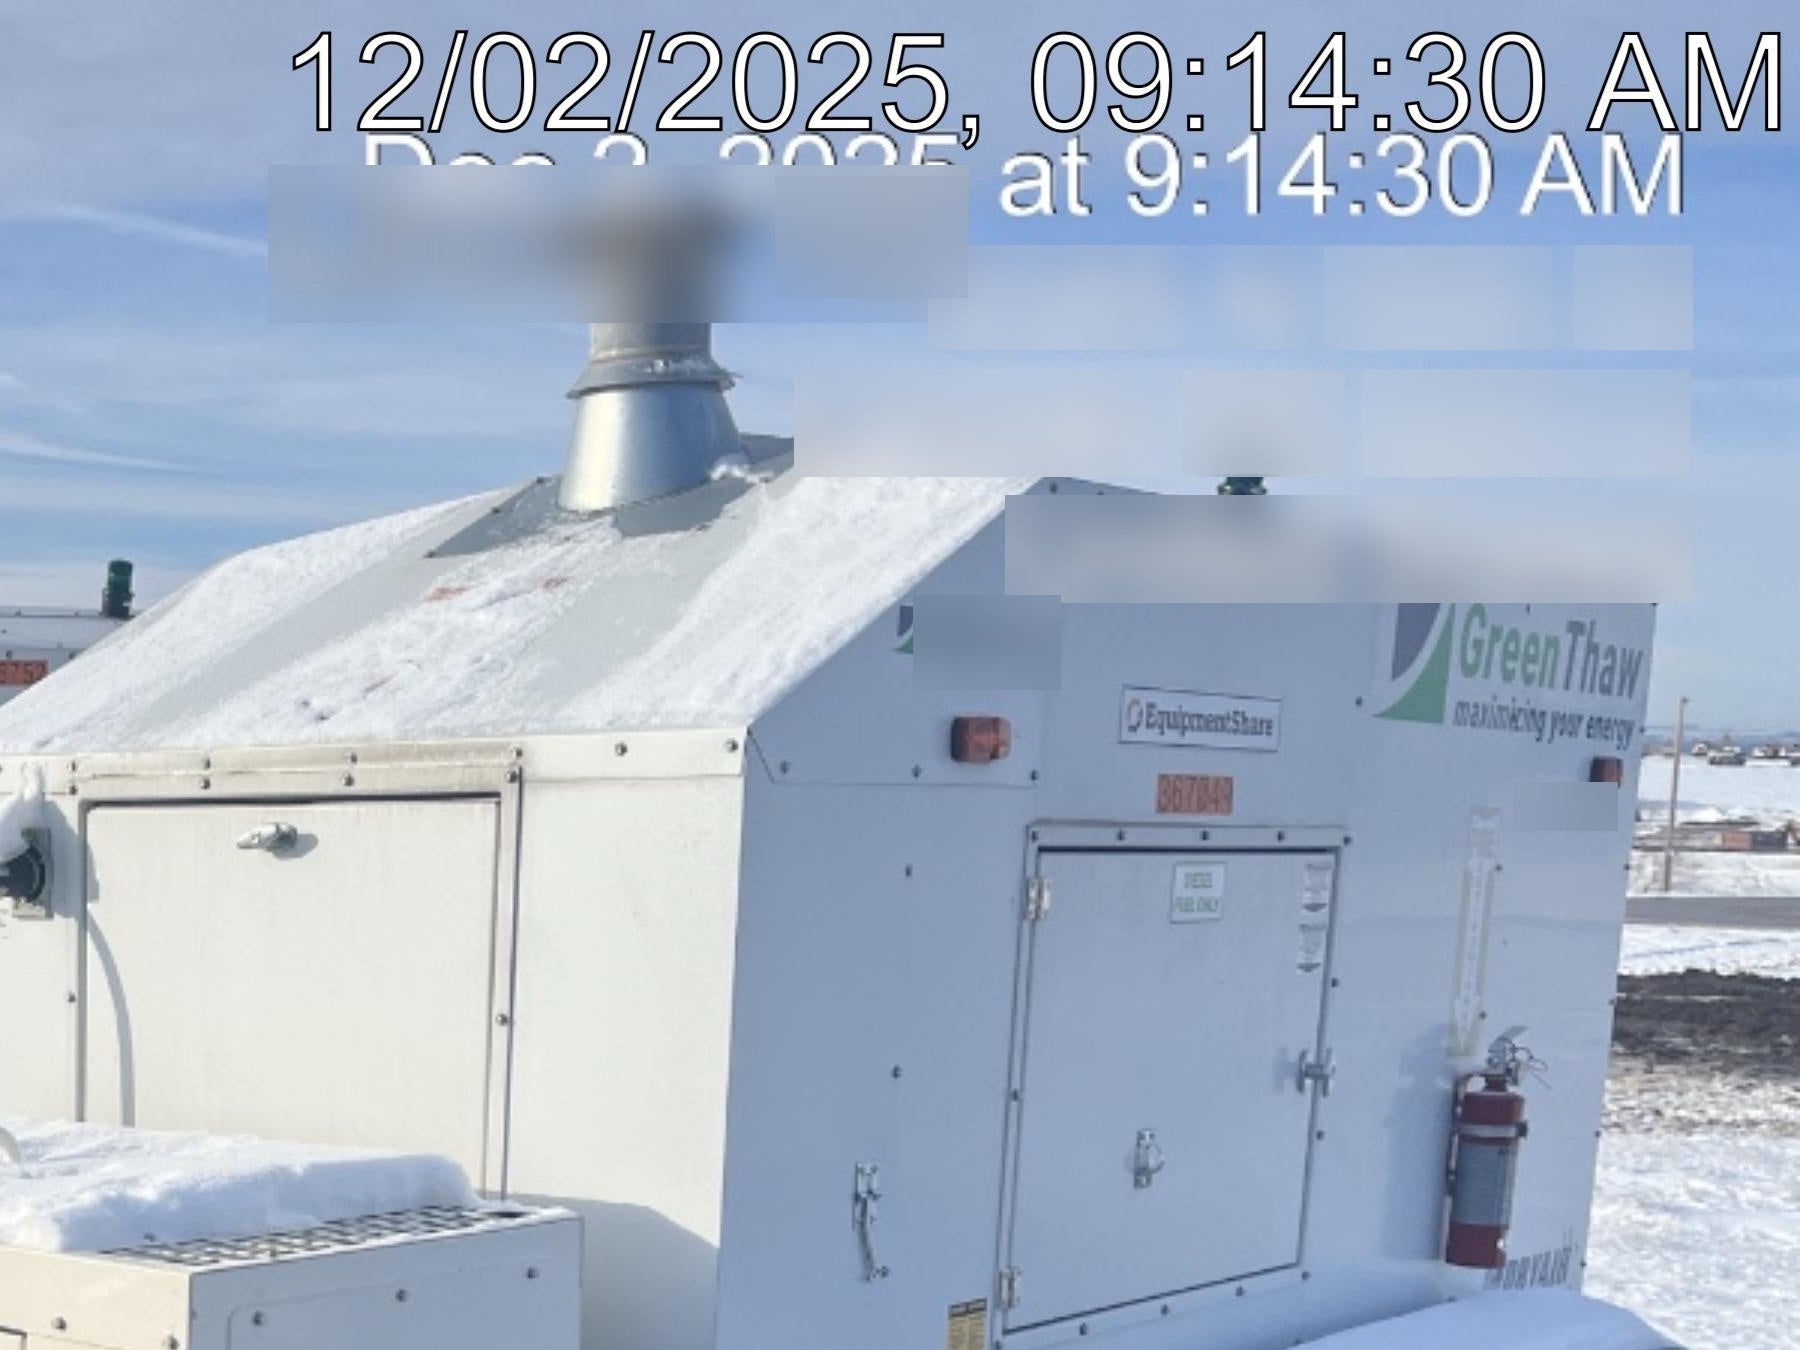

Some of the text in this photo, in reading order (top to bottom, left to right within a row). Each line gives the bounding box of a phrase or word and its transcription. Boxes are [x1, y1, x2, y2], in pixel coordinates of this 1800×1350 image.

[1145, 702, 1273, 737] EquipmentShare
[1452, 695, 1636, 751] maximizing your energy
